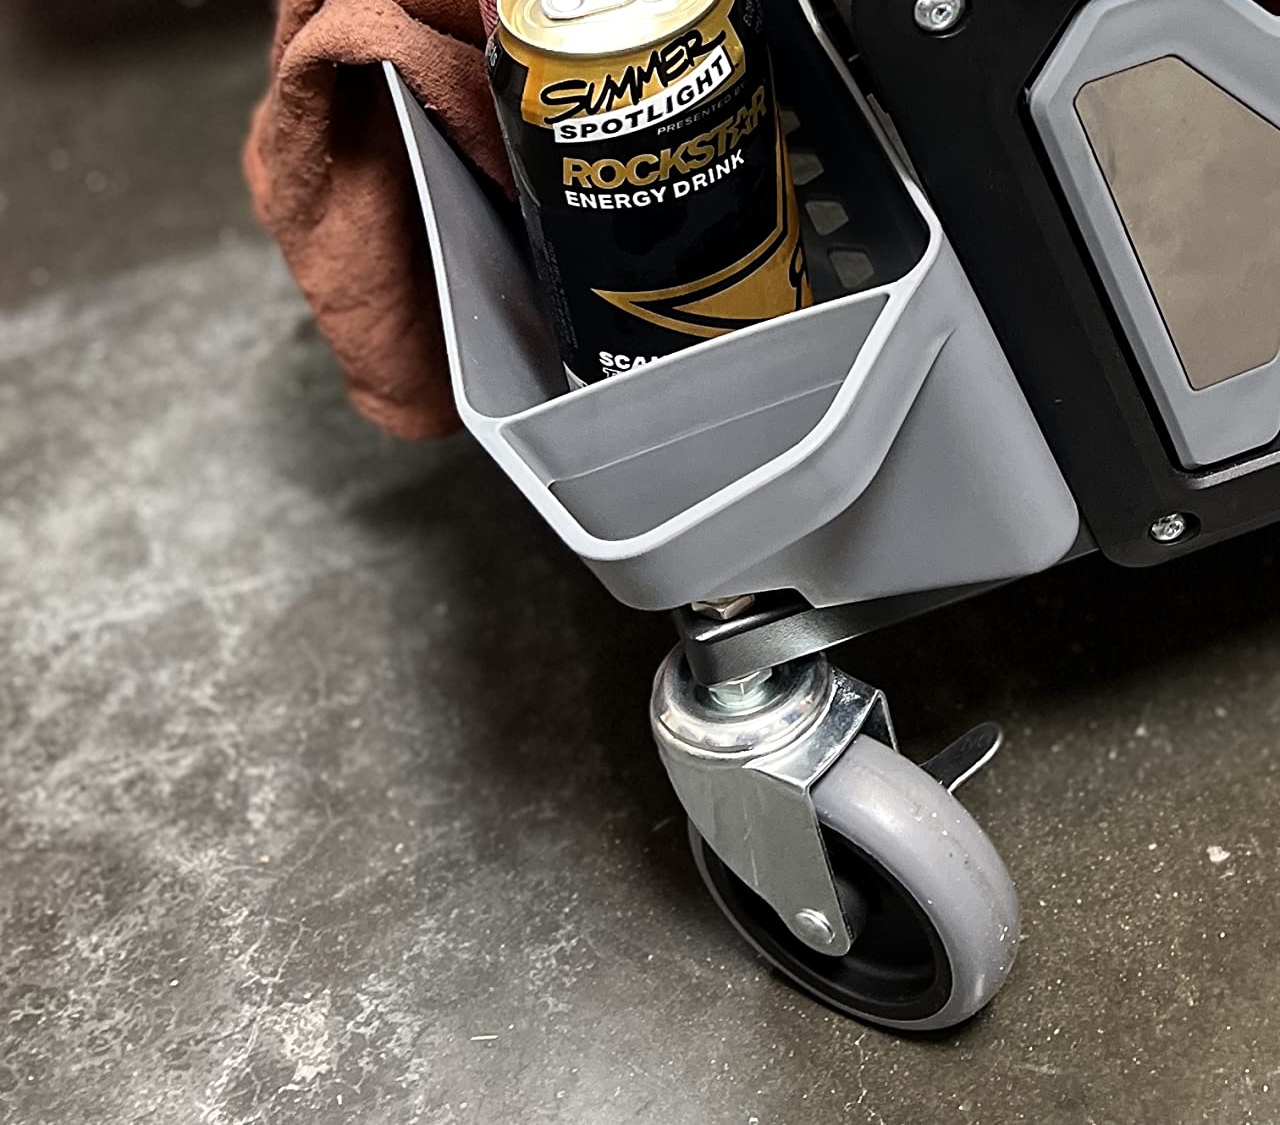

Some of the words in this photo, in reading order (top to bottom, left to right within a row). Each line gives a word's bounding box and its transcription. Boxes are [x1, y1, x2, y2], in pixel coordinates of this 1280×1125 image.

[540, 29, 726, 124] SUMMER
[560, 54, 724, 139] SPOTLIGHT
[657, 94, 731, 135] PRESENTED
[563, 85, 767, 190] ROCKSTAR
[564, 186, 668, 209] ENERGY
[673, 149, 745, 199] DRINK
